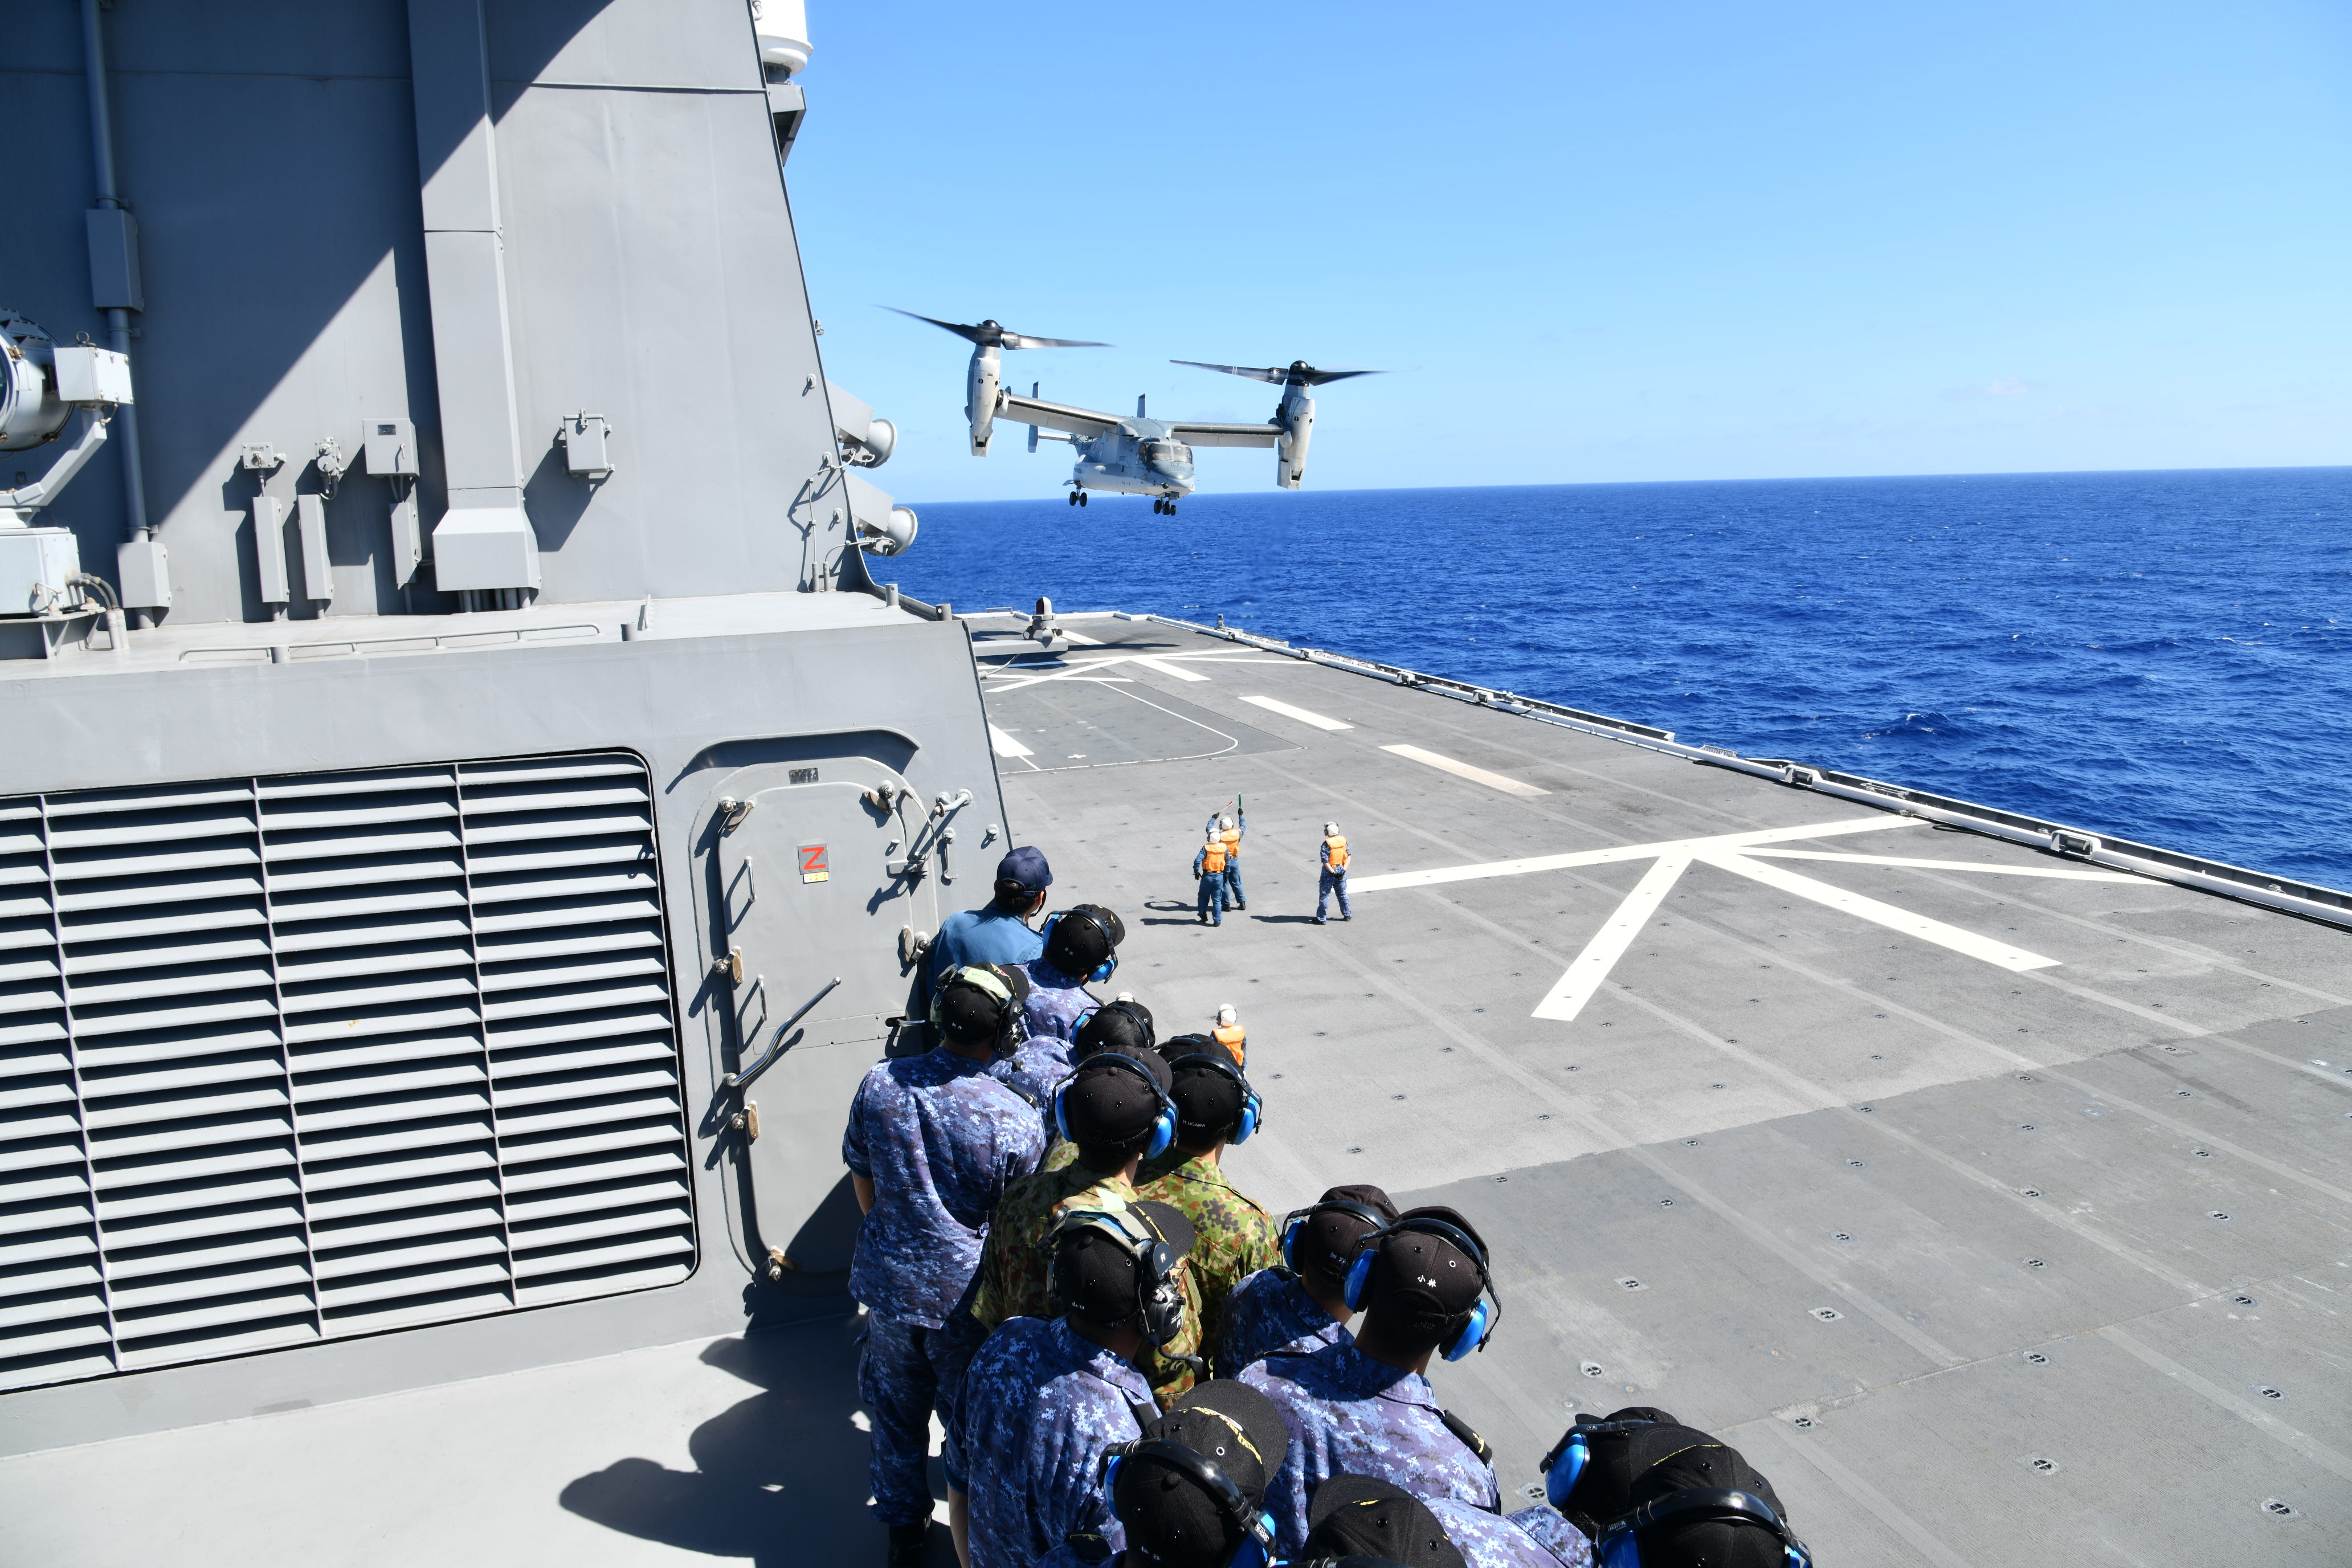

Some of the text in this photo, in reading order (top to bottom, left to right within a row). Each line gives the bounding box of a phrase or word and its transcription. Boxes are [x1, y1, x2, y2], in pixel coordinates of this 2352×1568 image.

[802, 847, 826, 870] Z
[1160, 1253, 1166, 1263] R
[1417, 1274, 1436, 1288] 小林
